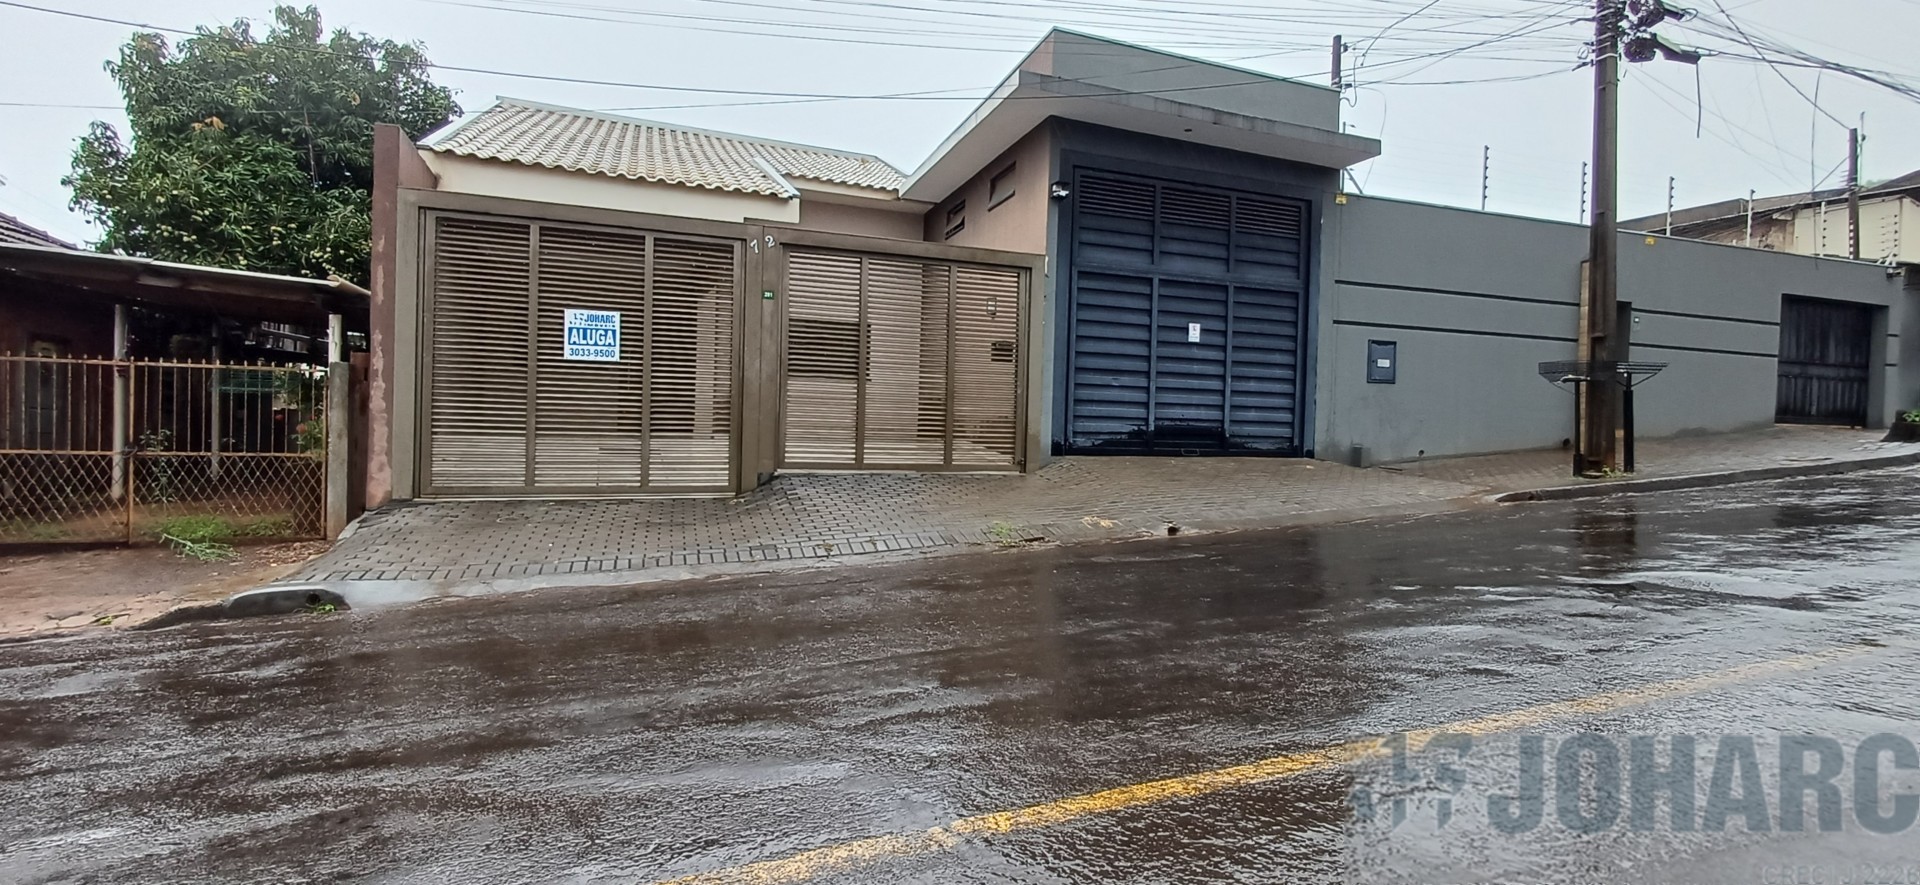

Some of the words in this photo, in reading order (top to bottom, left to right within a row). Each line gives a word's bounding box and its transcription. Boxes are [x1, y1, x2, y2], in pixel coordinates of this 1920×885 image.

[584, 313, 616, 324] JOHARC
[569, 328, 615, 346] ALUGA
[569, 347, 616, 358] 3033-9500
